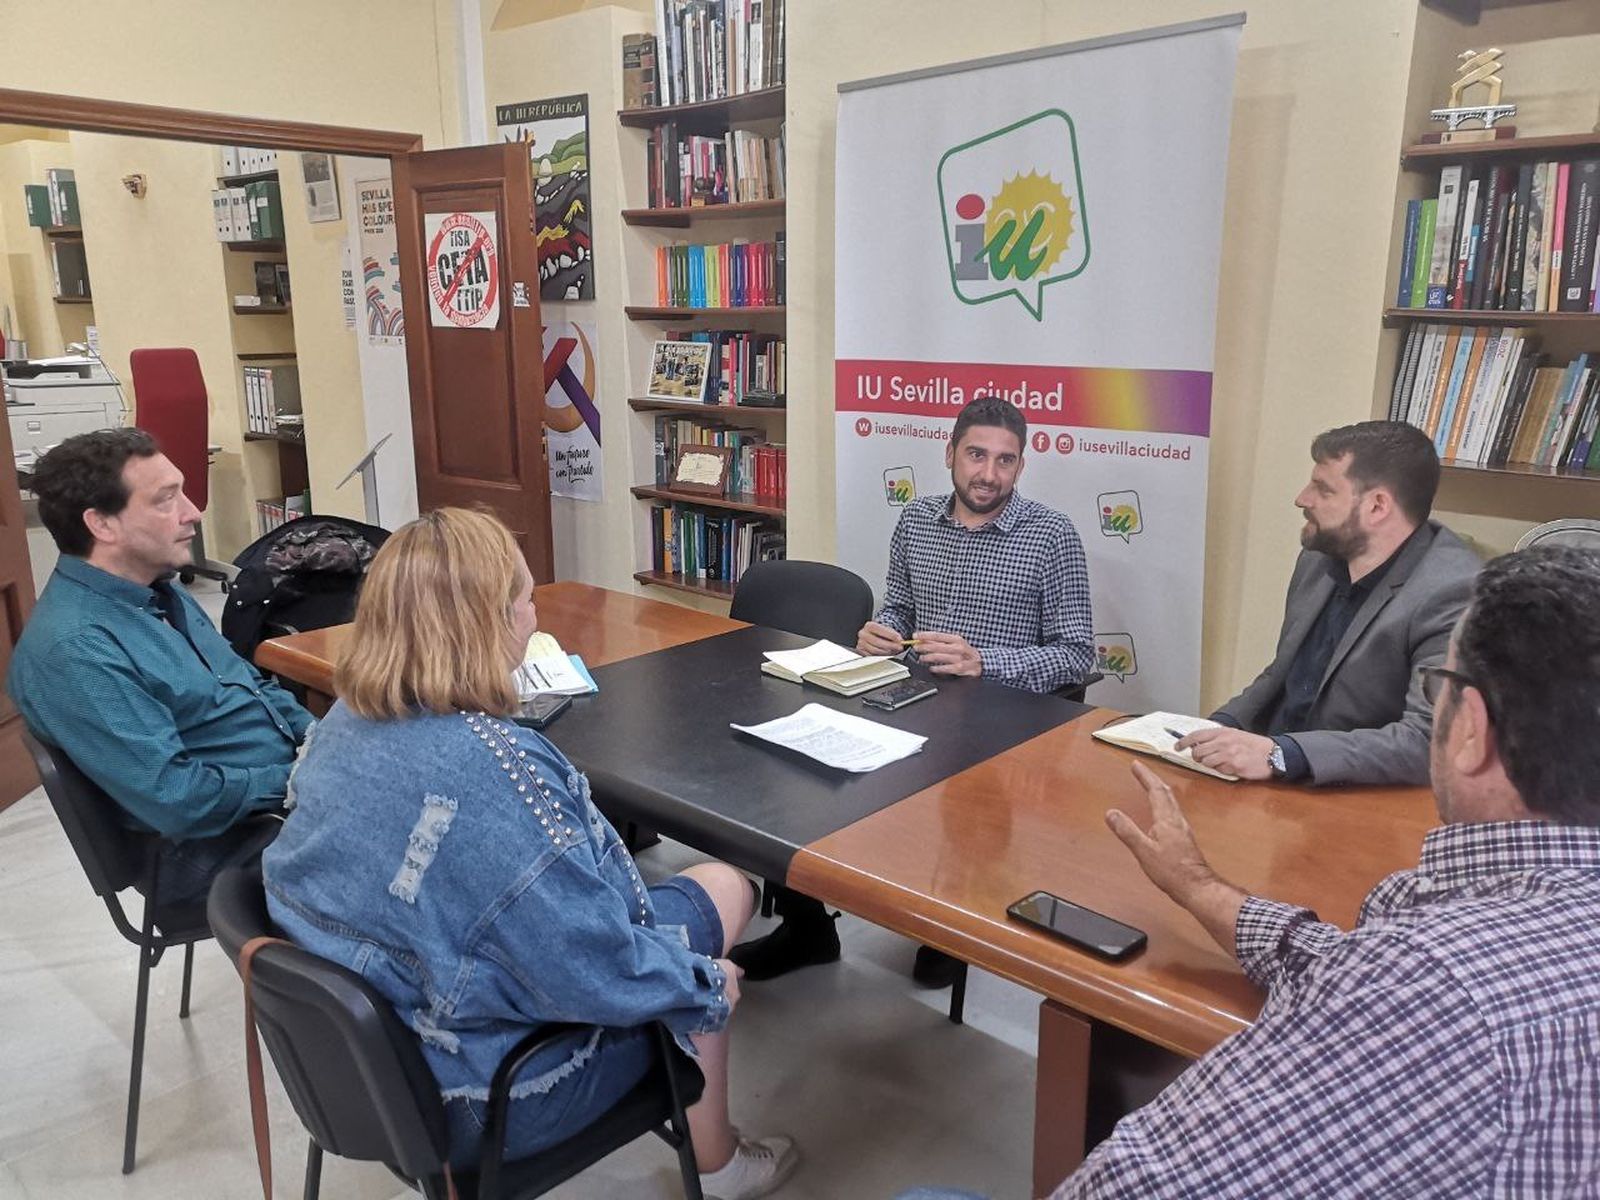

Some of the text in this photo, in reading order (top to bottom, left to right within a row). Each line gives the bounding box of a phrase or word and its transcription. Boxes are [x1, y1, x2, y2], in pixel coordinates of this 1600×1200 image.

[499, 109, 511, 121] LA
[361, 188, 391, 201] SEVILLA
[363, 214, 395, 226] COLOUR
[437, 248, 489, 291] CETA
[858, 375, 1063, 411] IU Sevilla ciudad
[1079, 438, 1191, 461] iusevillaciudad
